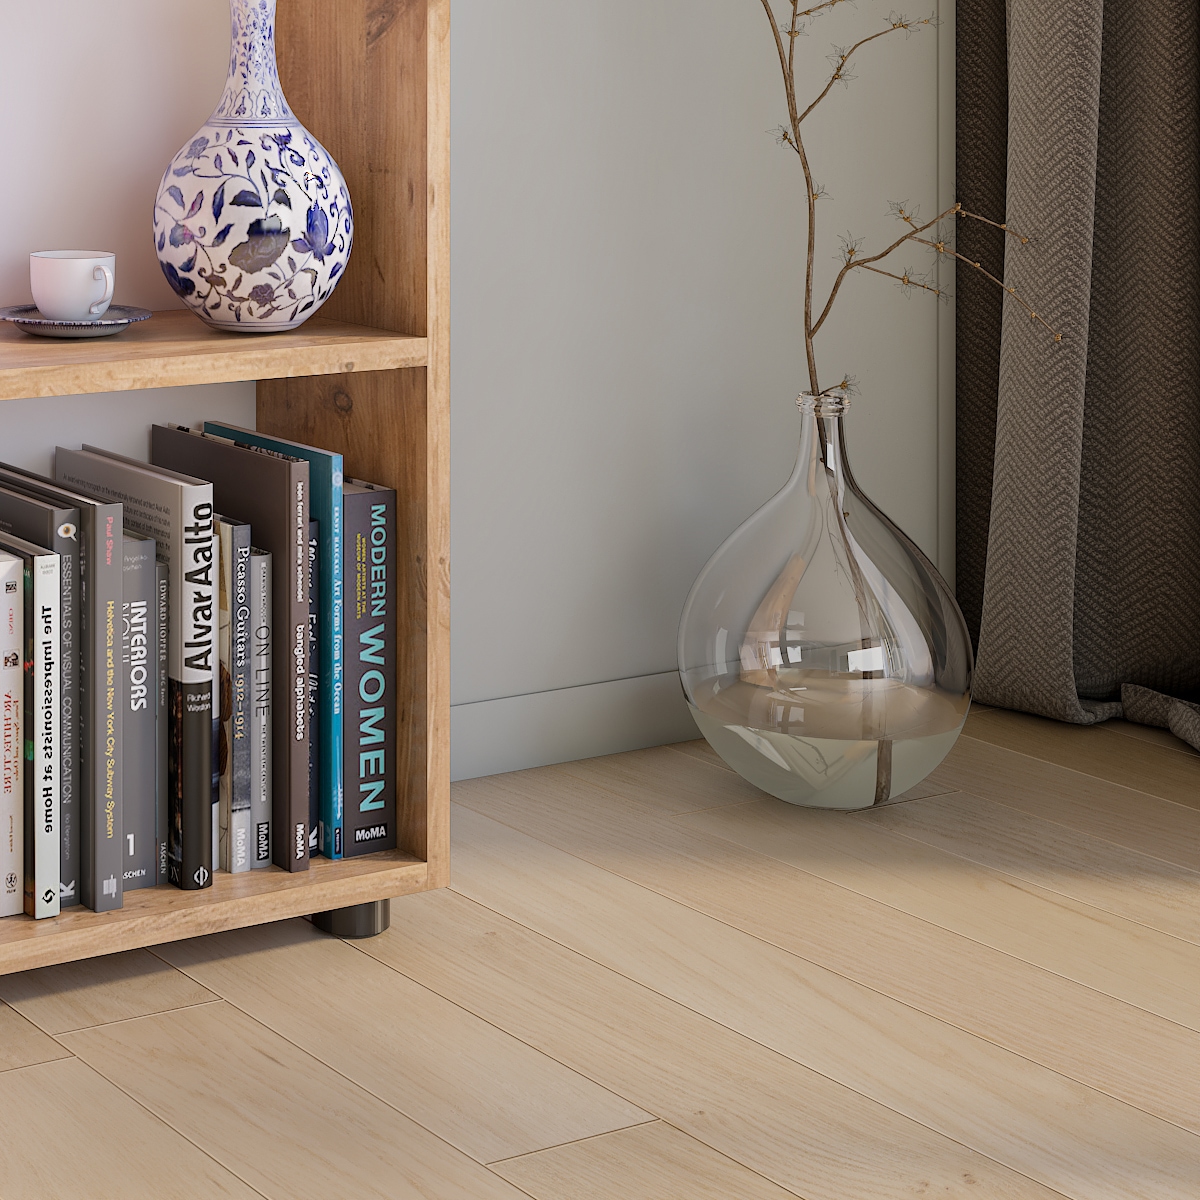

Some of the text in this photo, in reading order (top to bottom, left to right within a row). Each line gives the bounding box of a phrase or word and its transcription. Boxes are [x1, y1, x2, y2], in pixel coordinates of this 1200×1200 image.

[106, 516, 114, 565] Paul Shaw
[184, 503, 213, 672] Alvar Aalto
[236, 546, 251, 604] Picasso
[334, 579, 342, 596] Art
[159, 579, 167, 662] EDWARD HOPPER
[236, 606, 250, 668] Guitars
[333, 599, 342, 632] Forms
[130, 600, 148, 711] INTERIORS
[333, 662, 342, 680] the
[334, 634, 342, 659] from
[358, 504, 387, 813] MODERN WOMEN
[62, 554, 72, 804] ESSENTIALS OF VISUAL COMMUNICATION
[254, 625, 271, 718] ON LINE
[293, 624, 306, 741] tangled alphabets
[104, 600, 115, 839] Helvetica and the New York City Subway System
[333, 682, 342, 715] Ocean
[126, 833, 135, 856] 1
[235, 828, 246, 867] MoMA
[257, 823, 269, 859] MoMA
[295, 823, 305, 860] MoMA
[354, 828, 387, 842] MoMA
